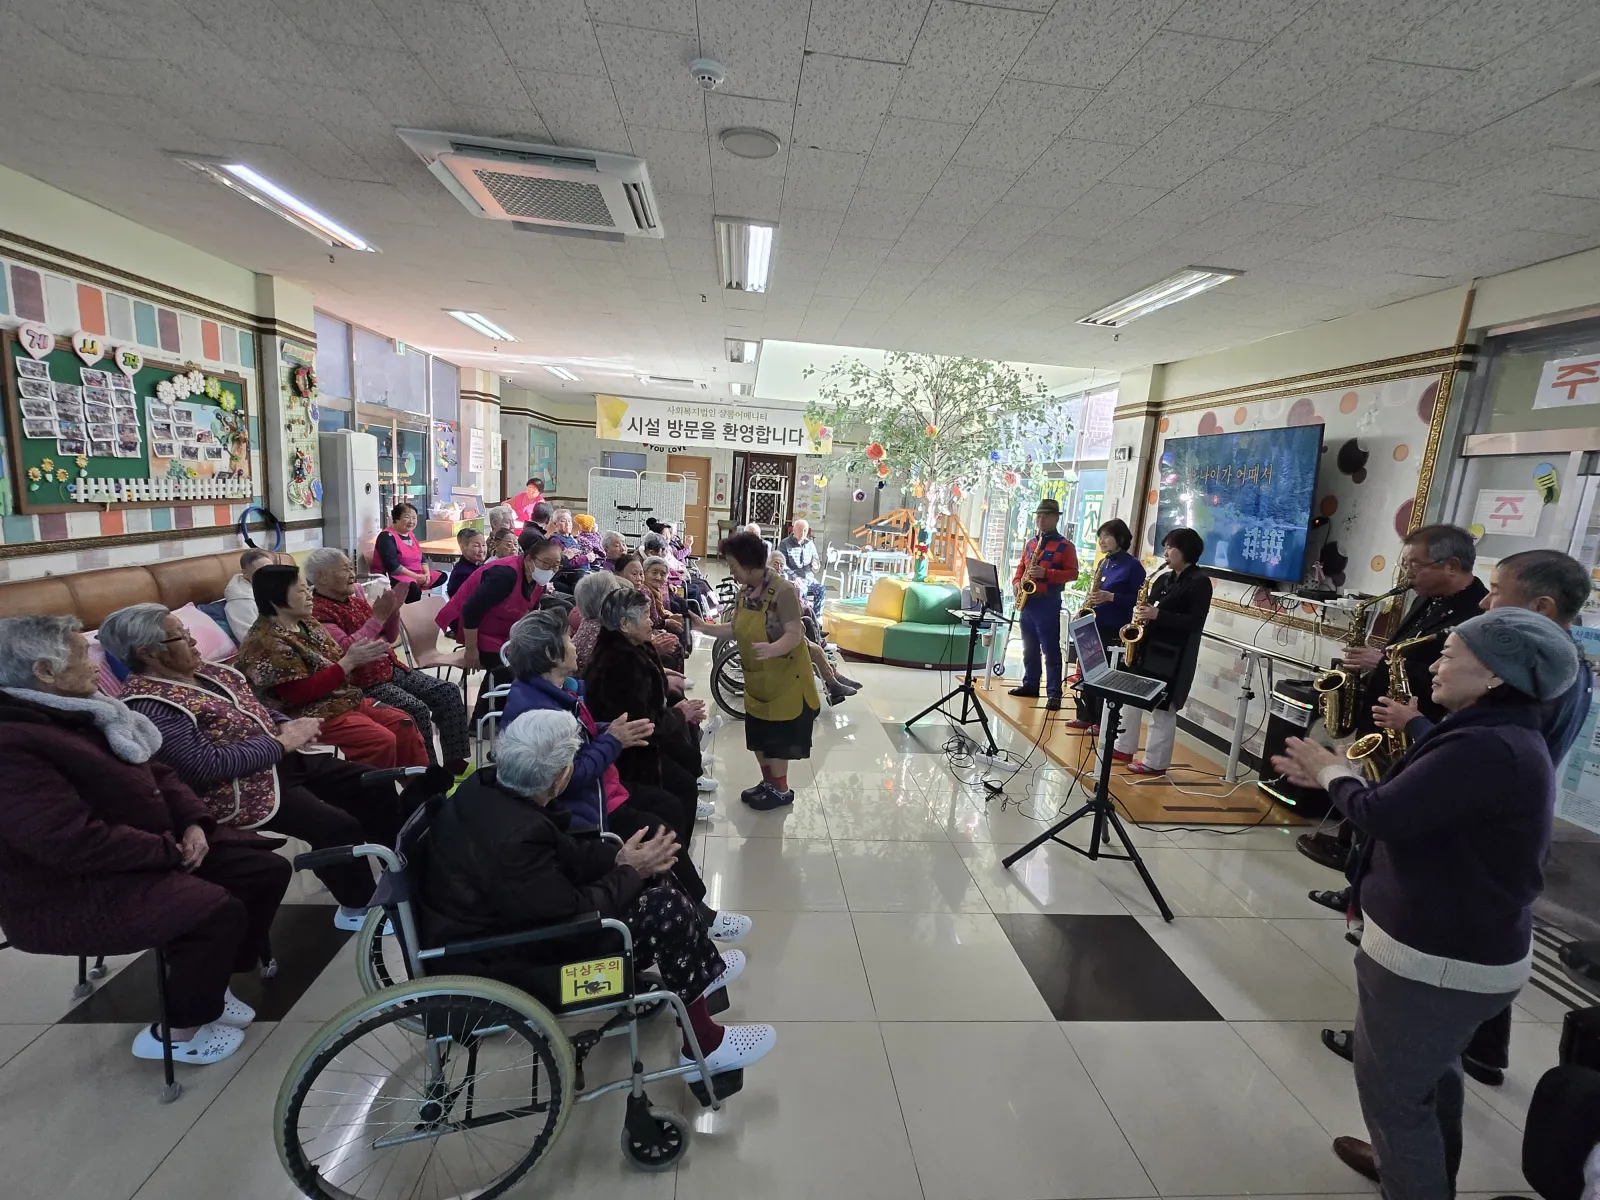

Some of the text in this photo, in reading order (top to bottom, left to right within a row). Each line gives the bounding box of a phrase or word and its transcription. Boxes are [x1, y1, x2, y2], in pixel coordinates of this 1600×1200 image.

[1551, 360, 1600, 400] 주
[666, 406, 717, 418] 사회복지법인
[627, 416, 804, 447] 시설 방문을 환영합니다
[649, 444, 687, 453] YOU LOVE
[1200, 464, 1232, 485] 나이가
[1236, 463, 1273, 485] 어때서
[1488, 496, 1525, 528] 주
[565, 959, 620, 978] 낙상주의
